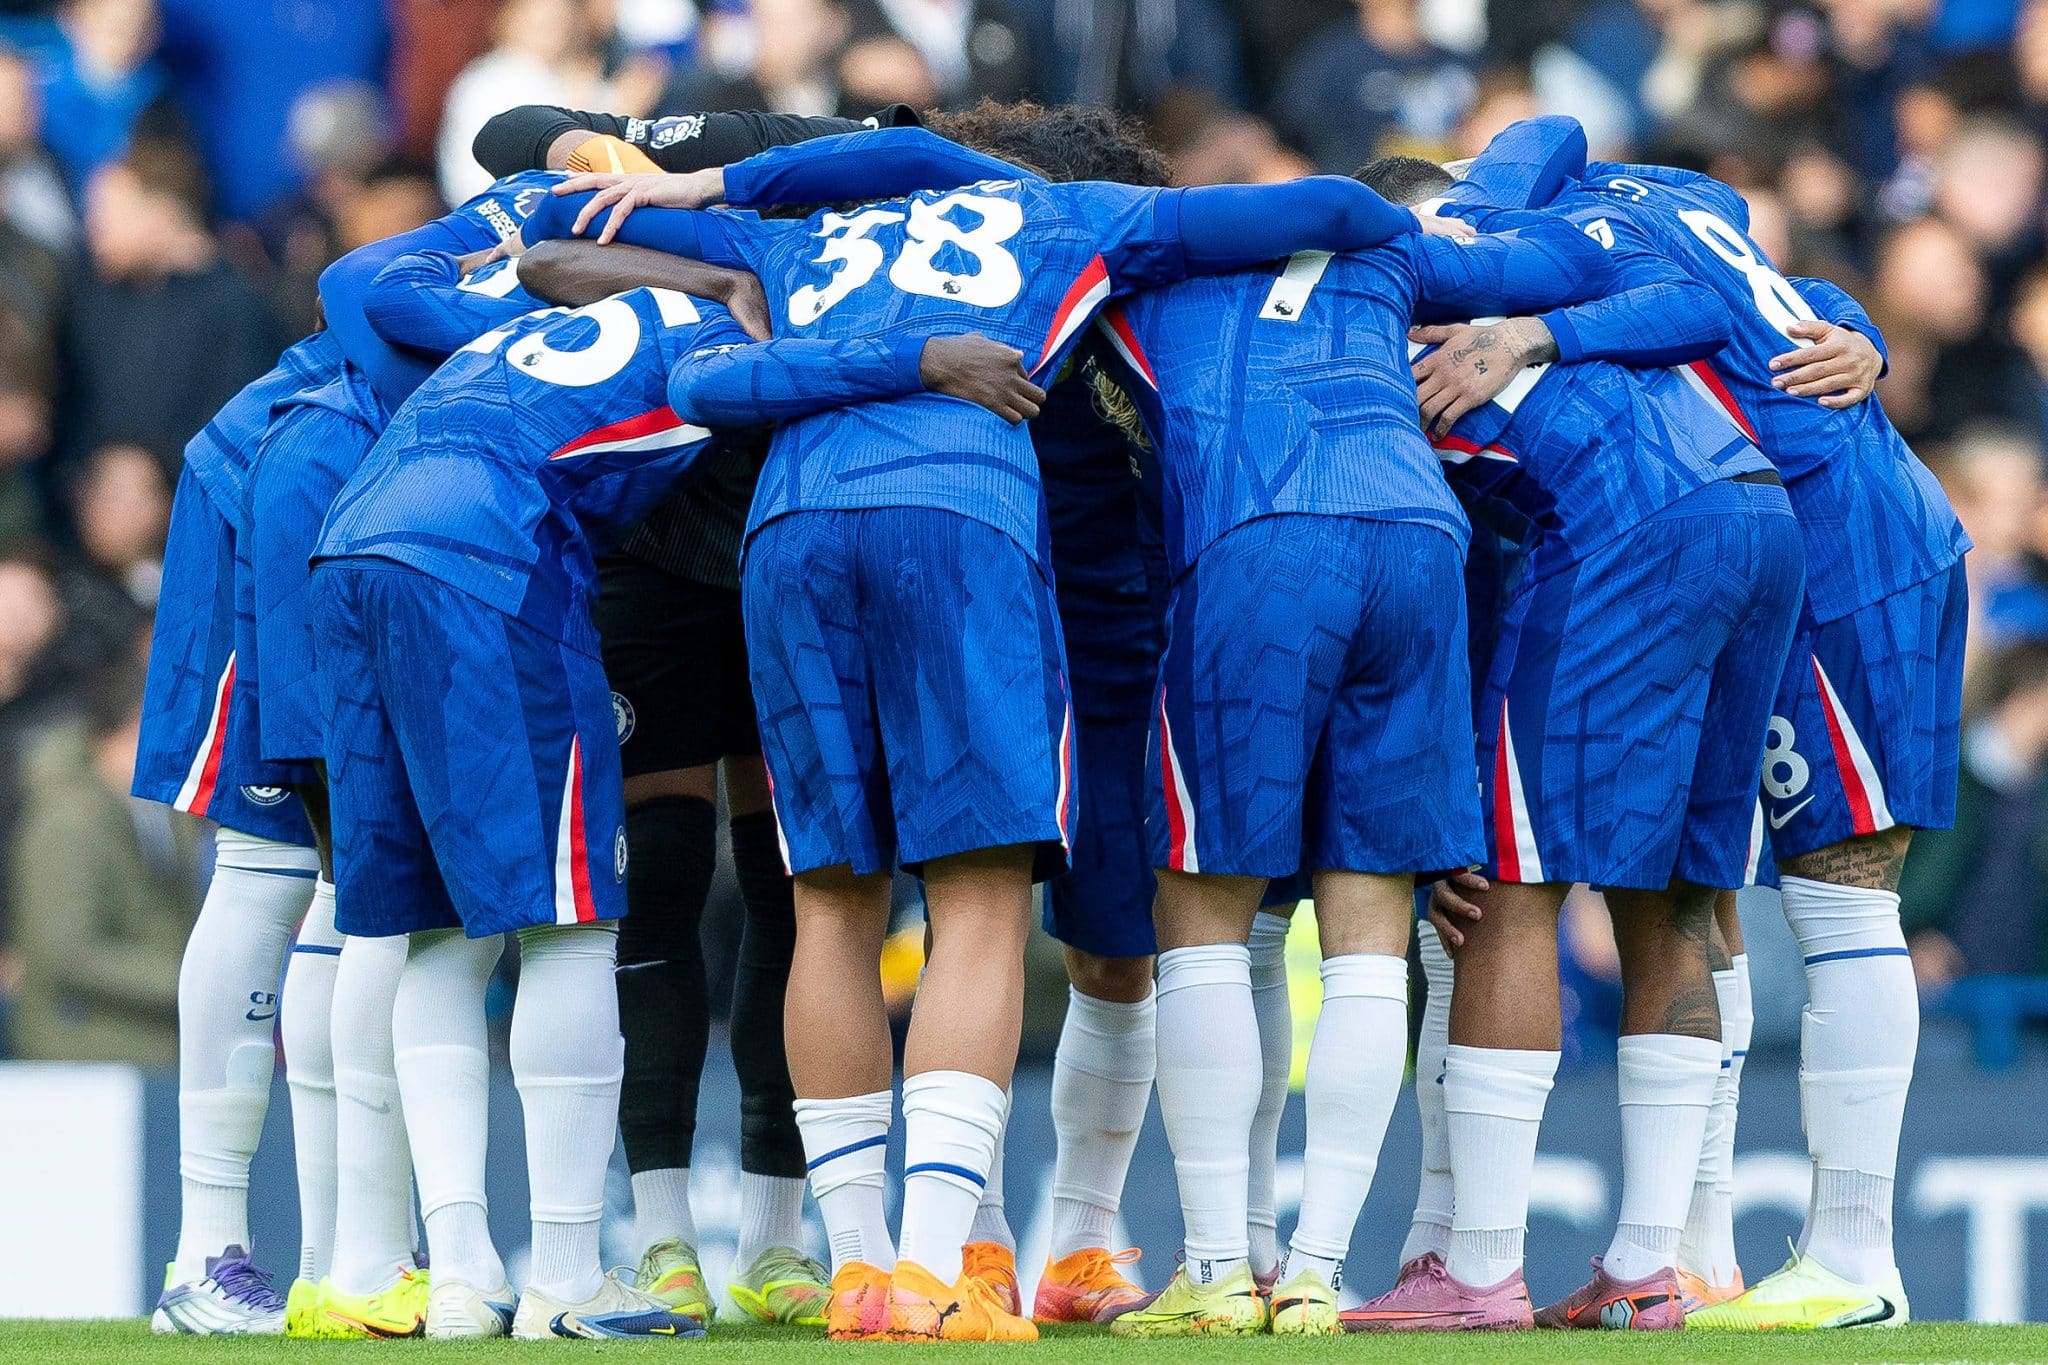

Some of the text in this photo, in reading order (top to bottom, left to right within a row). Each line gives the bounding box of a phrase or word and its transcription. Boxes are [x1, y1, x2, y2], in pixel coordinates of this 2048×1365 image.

[788, 193, 1024, 327] 38
[1677, 208, 1818, 350] 8
[1762, 715, 1809, 798] 8
[250, 991, 278, 1005] CF
